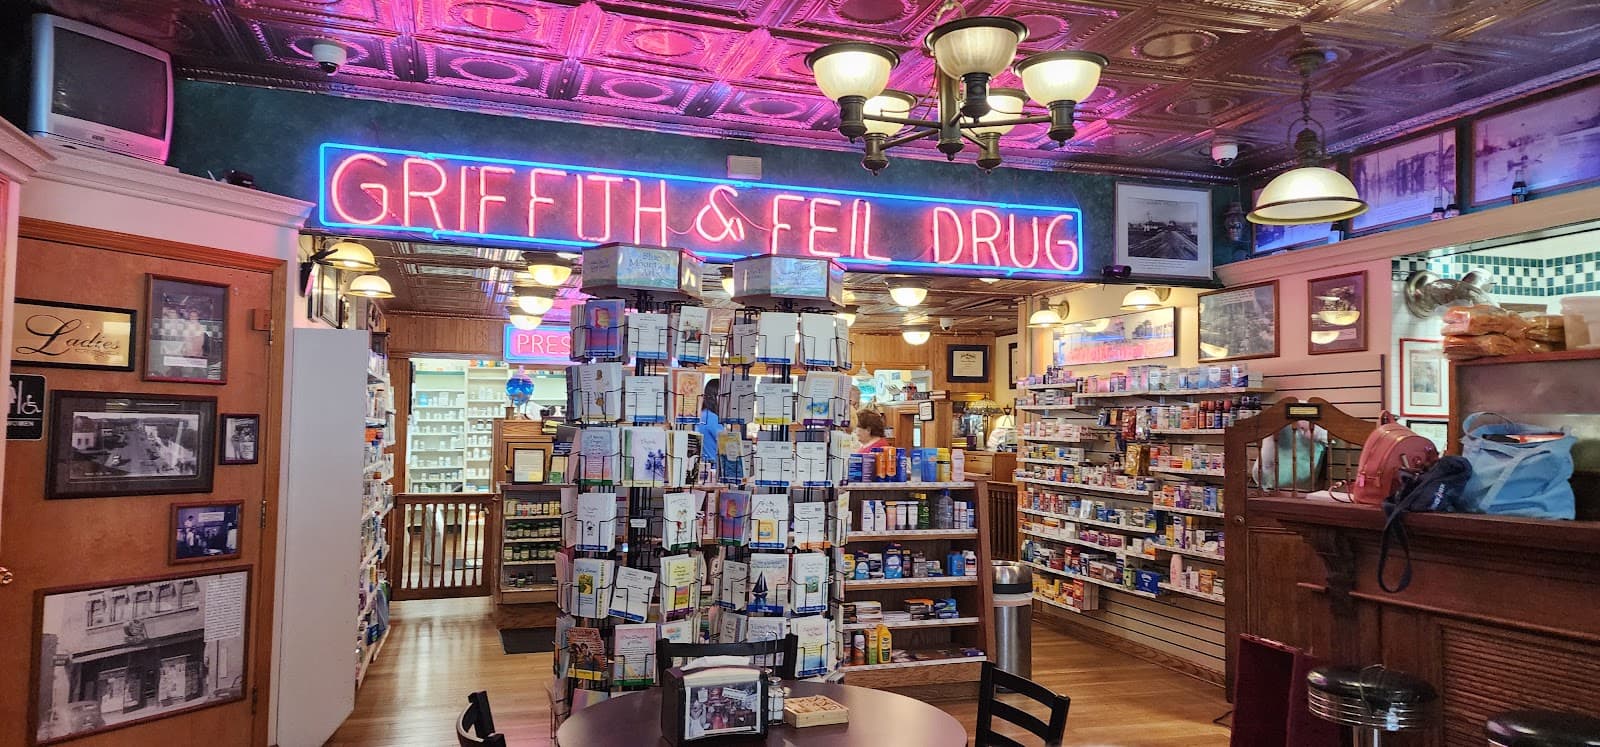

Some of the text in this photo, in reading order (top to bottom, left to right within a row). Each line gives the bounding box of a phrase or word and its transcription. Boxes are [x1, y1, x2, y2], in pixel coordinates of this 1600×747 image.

[331, 153, 1078, 272] GRIFFITH & FEIL DRUG
[15, 314, 121, 357] Ladies
